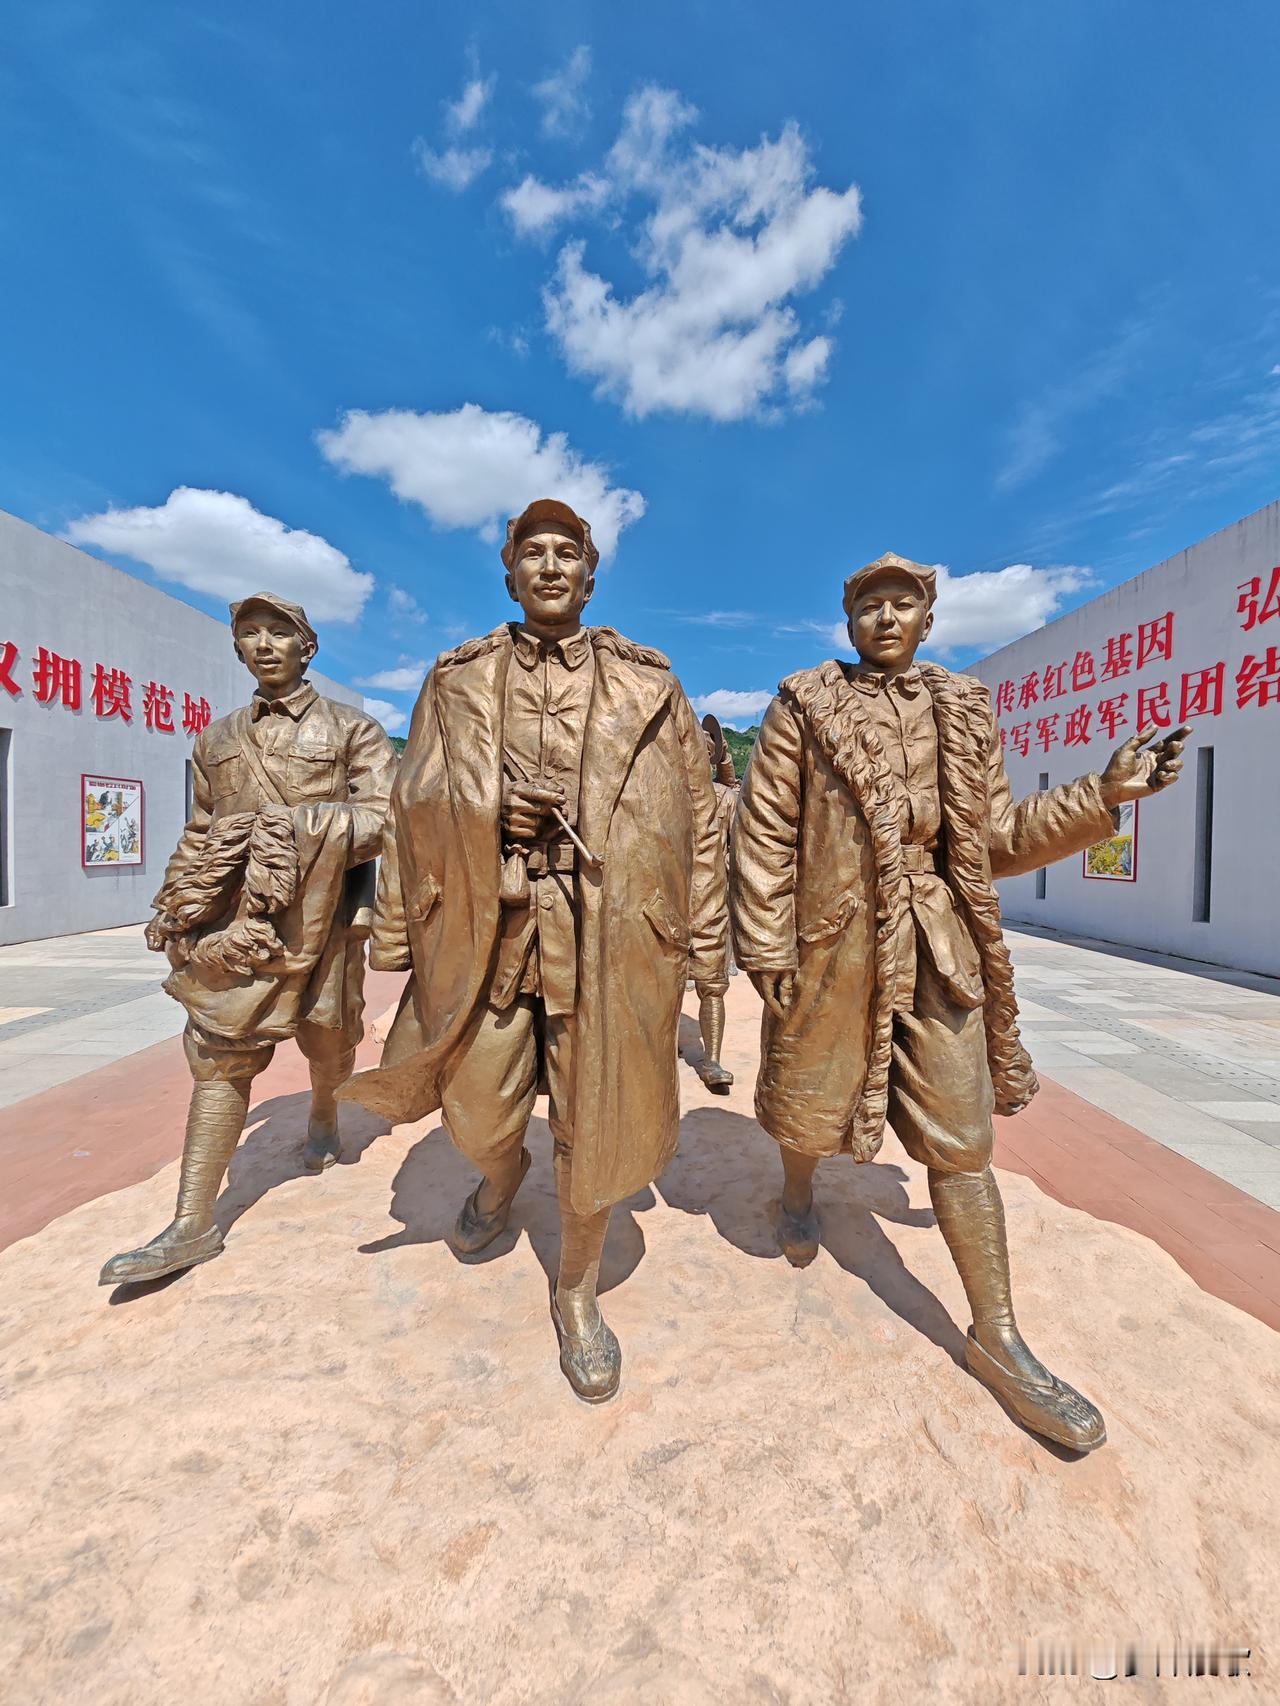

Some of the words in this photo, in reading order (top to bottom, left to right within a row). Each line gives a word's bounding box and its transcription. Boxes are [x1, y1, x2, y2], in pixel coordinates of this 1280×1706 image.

[996, 611, 1174, 718] 传承红色基因
[1000, 646, 1280, 757] 写军政军民团结
